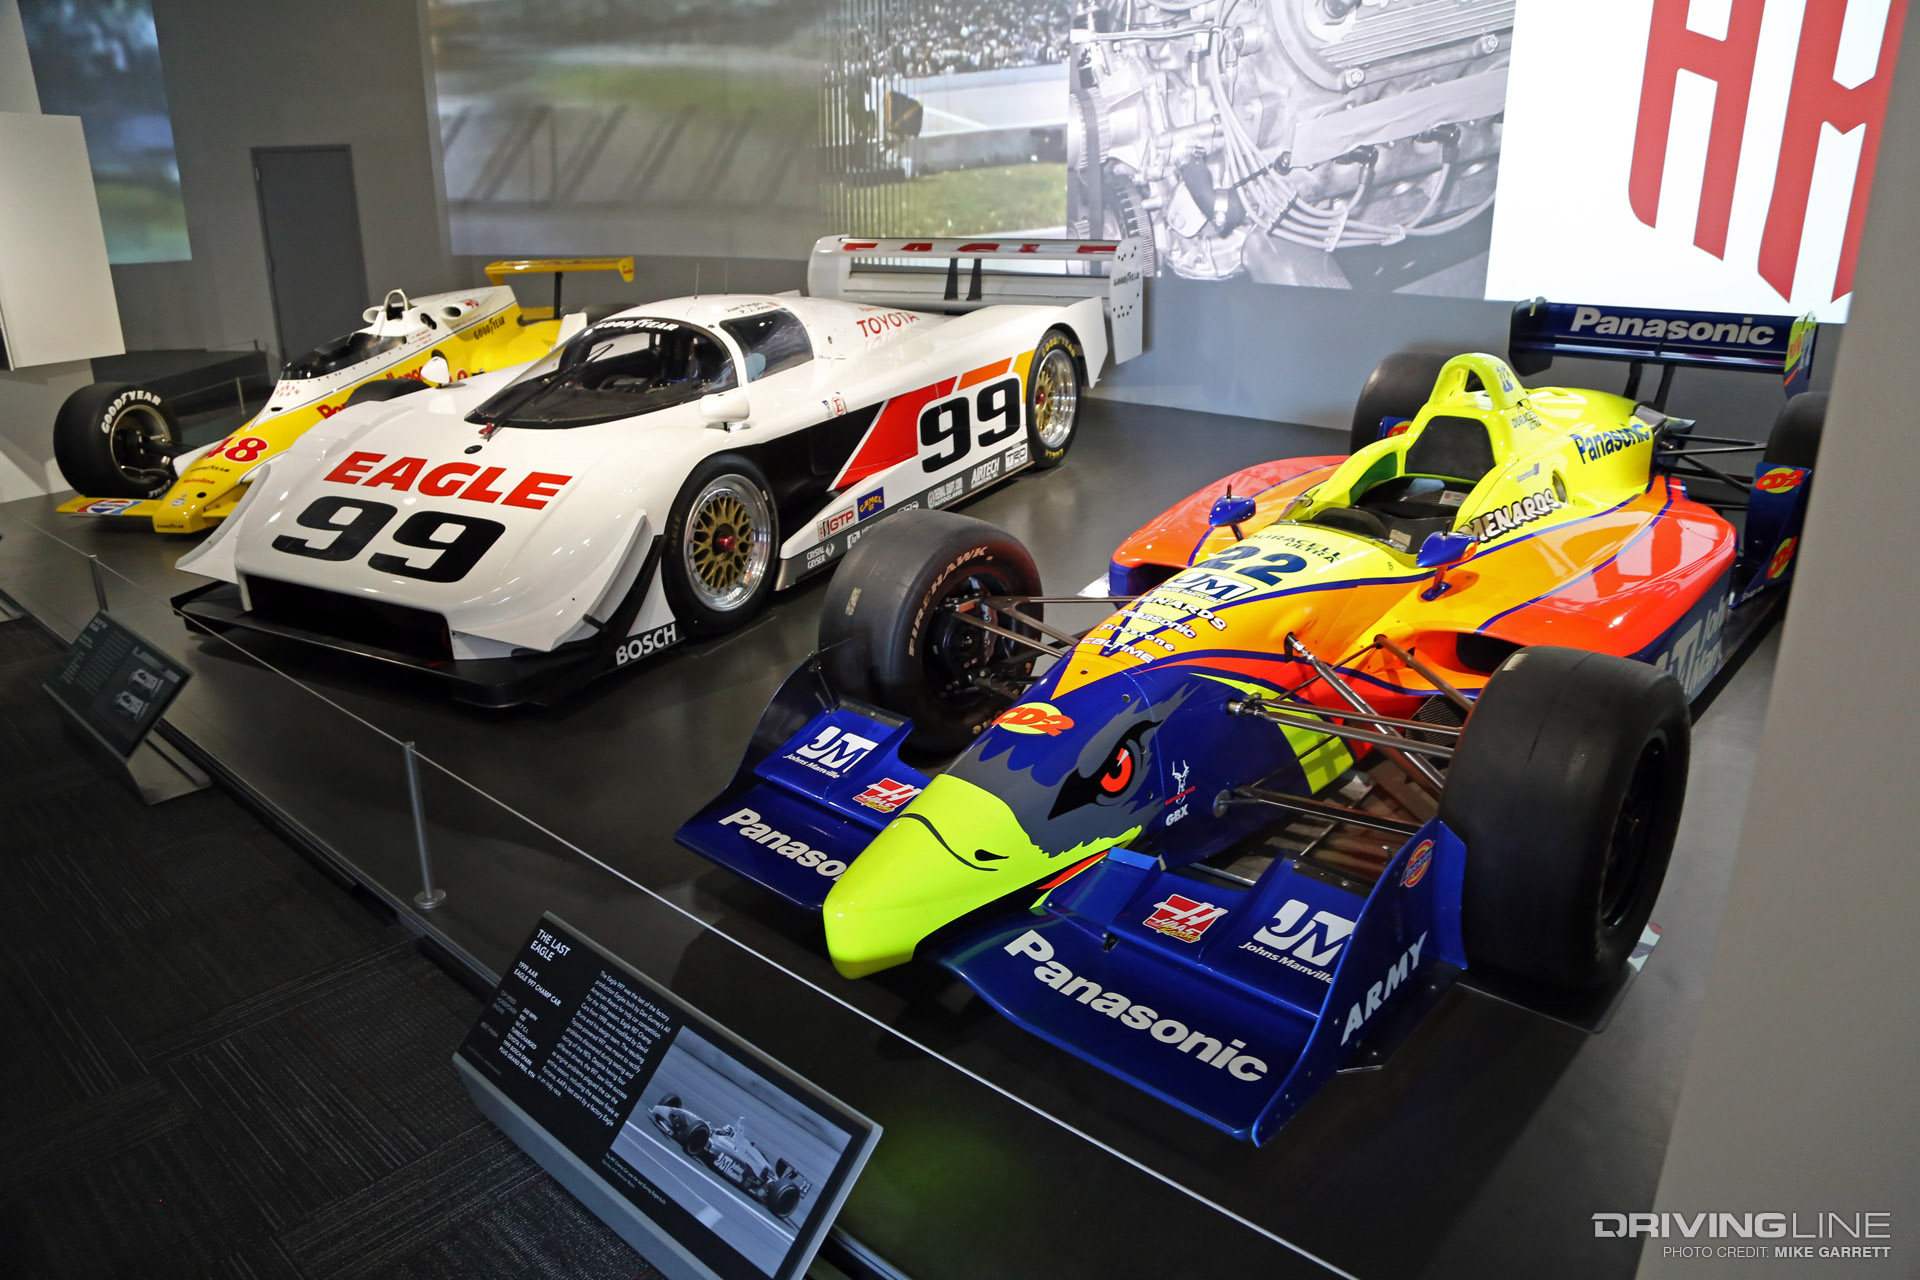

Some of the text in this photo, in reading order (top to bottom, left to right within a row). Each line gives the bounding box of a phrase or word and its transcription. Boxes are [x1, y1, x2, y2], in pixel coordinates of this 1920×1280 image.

[1113, 272, 1140, 287] GOODYEAR
[473, 316, 505, 340] GOODYEAR
[594, 318, 680, 331] GOODYEAR
[856, 311, 921, 338] TOYOTA
[1569, 306, 1775, 345] Panasonic
[1042, 336, 1075, 358] GOODYEAR
[101, 390, 162, 434] GOODYEAR
[920, 377, 1021, 473] 99
[202, 434, 268, 462] 48
[1569, 423, 1651, 464] Panasonic
[324, 452, 573, 510] EAGLE
[971, 457, 1000, 484] AIRTECH
[829, 510, 855, 531] GTP
[859, 495, 883, 513] CAMEL
[1457, 488, 1562, 543] MENARDS
[271, 496, 506, 583] 99
[806, 546, 826, 560] CRYSTAL
[1249, 533, 1341, 561] DURACELL
[1285, 542, 1335, 563] ULTRA
[807, 554, 826, 569] GEYSER
[1191, 545, 1307, 586] 22
[1165, 573, 1250, 601] JM
[1112, 608, 1197, 638] Panasonic
[615, 624, 677, 666] BOSCH
[782, 753, 841, 779] Johns Manville
[796, 725, 879, 773] JM
[1165, 804, 1189, 827] GBX
[718, 808, 849, 882] Panaso
[531, 941, 554, 961] EAGLE
[538, 929, 570, 956] THE LAST
[1253, 899, 1358, 967] JM
[528, 969, 538, 978] AAR
[1238, 941, 1335, 984] Johns Manville
[514, 969, 528, 981] EAGLE
[535, 985, 551, 998] CHAMP
[551, 996, 561, 1006] CAR
[595, 980, 614, 994] production
[614, 992, 626, 1003] Eagles
[626, 1000, 634, 1009] built
[648, 1015, 664, 1029] Gurney's
[607, 976, 616, 985] Eagle
[656, 1009, 669, 1022] factory
[1003, 929, 1269, 1082] Panasonic
[1340, 931, 1428, 1046] ARMY
[581, 1003, 589, 1011] Cars
[590, 1008, 598, 1017] from
[615, 1029, 632, 1041] modified
[636, 1042, 648, 1053] David
[591, 987, 607, 1000] American
[607, 998, 618, 1009] Racers
[638, 1022, 660, 1039] competition.
[599, 1004, 608, 1012] 1999
[607, 1011, 619, 1022] season,
[620, 1019, 630, 1029] Eagle
[638, 1032, 651, 1044] Champ
[499, 1046, 508, 1056] PLUG
[508, 1054, 519, 1065] GRAND
[507, 1033, 519, 1045] TOYOTA
[510, 1046, 521, 1056] BOSCH
[521, 1055, 532, 1065] SPARK
[512, 1027, 536, 1049] TURBOCHARGED
[566, 1028, 625, 1074] problems discovered during testing
[572, 1018, 598, 1040] Toyota-powered
[612, 1050, 624, 1060] meant
[628, 1062, 640, 1073] rectify
[598, 1028, 610, 1038] design
[610, 1036, 620, 1045] team.
[628, 1050, 644, 1064] resulting
[556, 1055, 599, 1089] engine problems plagued
[557, 1043, 627, 1099] different drivers, little success
[562, 1035, 572, 1046] racing
[592, 1057, 605, 1070] Despite
[605, 1067, 617, 1080] having
[542, 1066, 556, 1080] Fontana,
[556, 1078, 567, 1089] AAR's
[573, 1092, 582, 1101] start
[590, 1104, 602, 1118] factory
[603, 1115, 613, 1126] Eagle
[547, 1059, 614, 1114] entire season, including season finale
